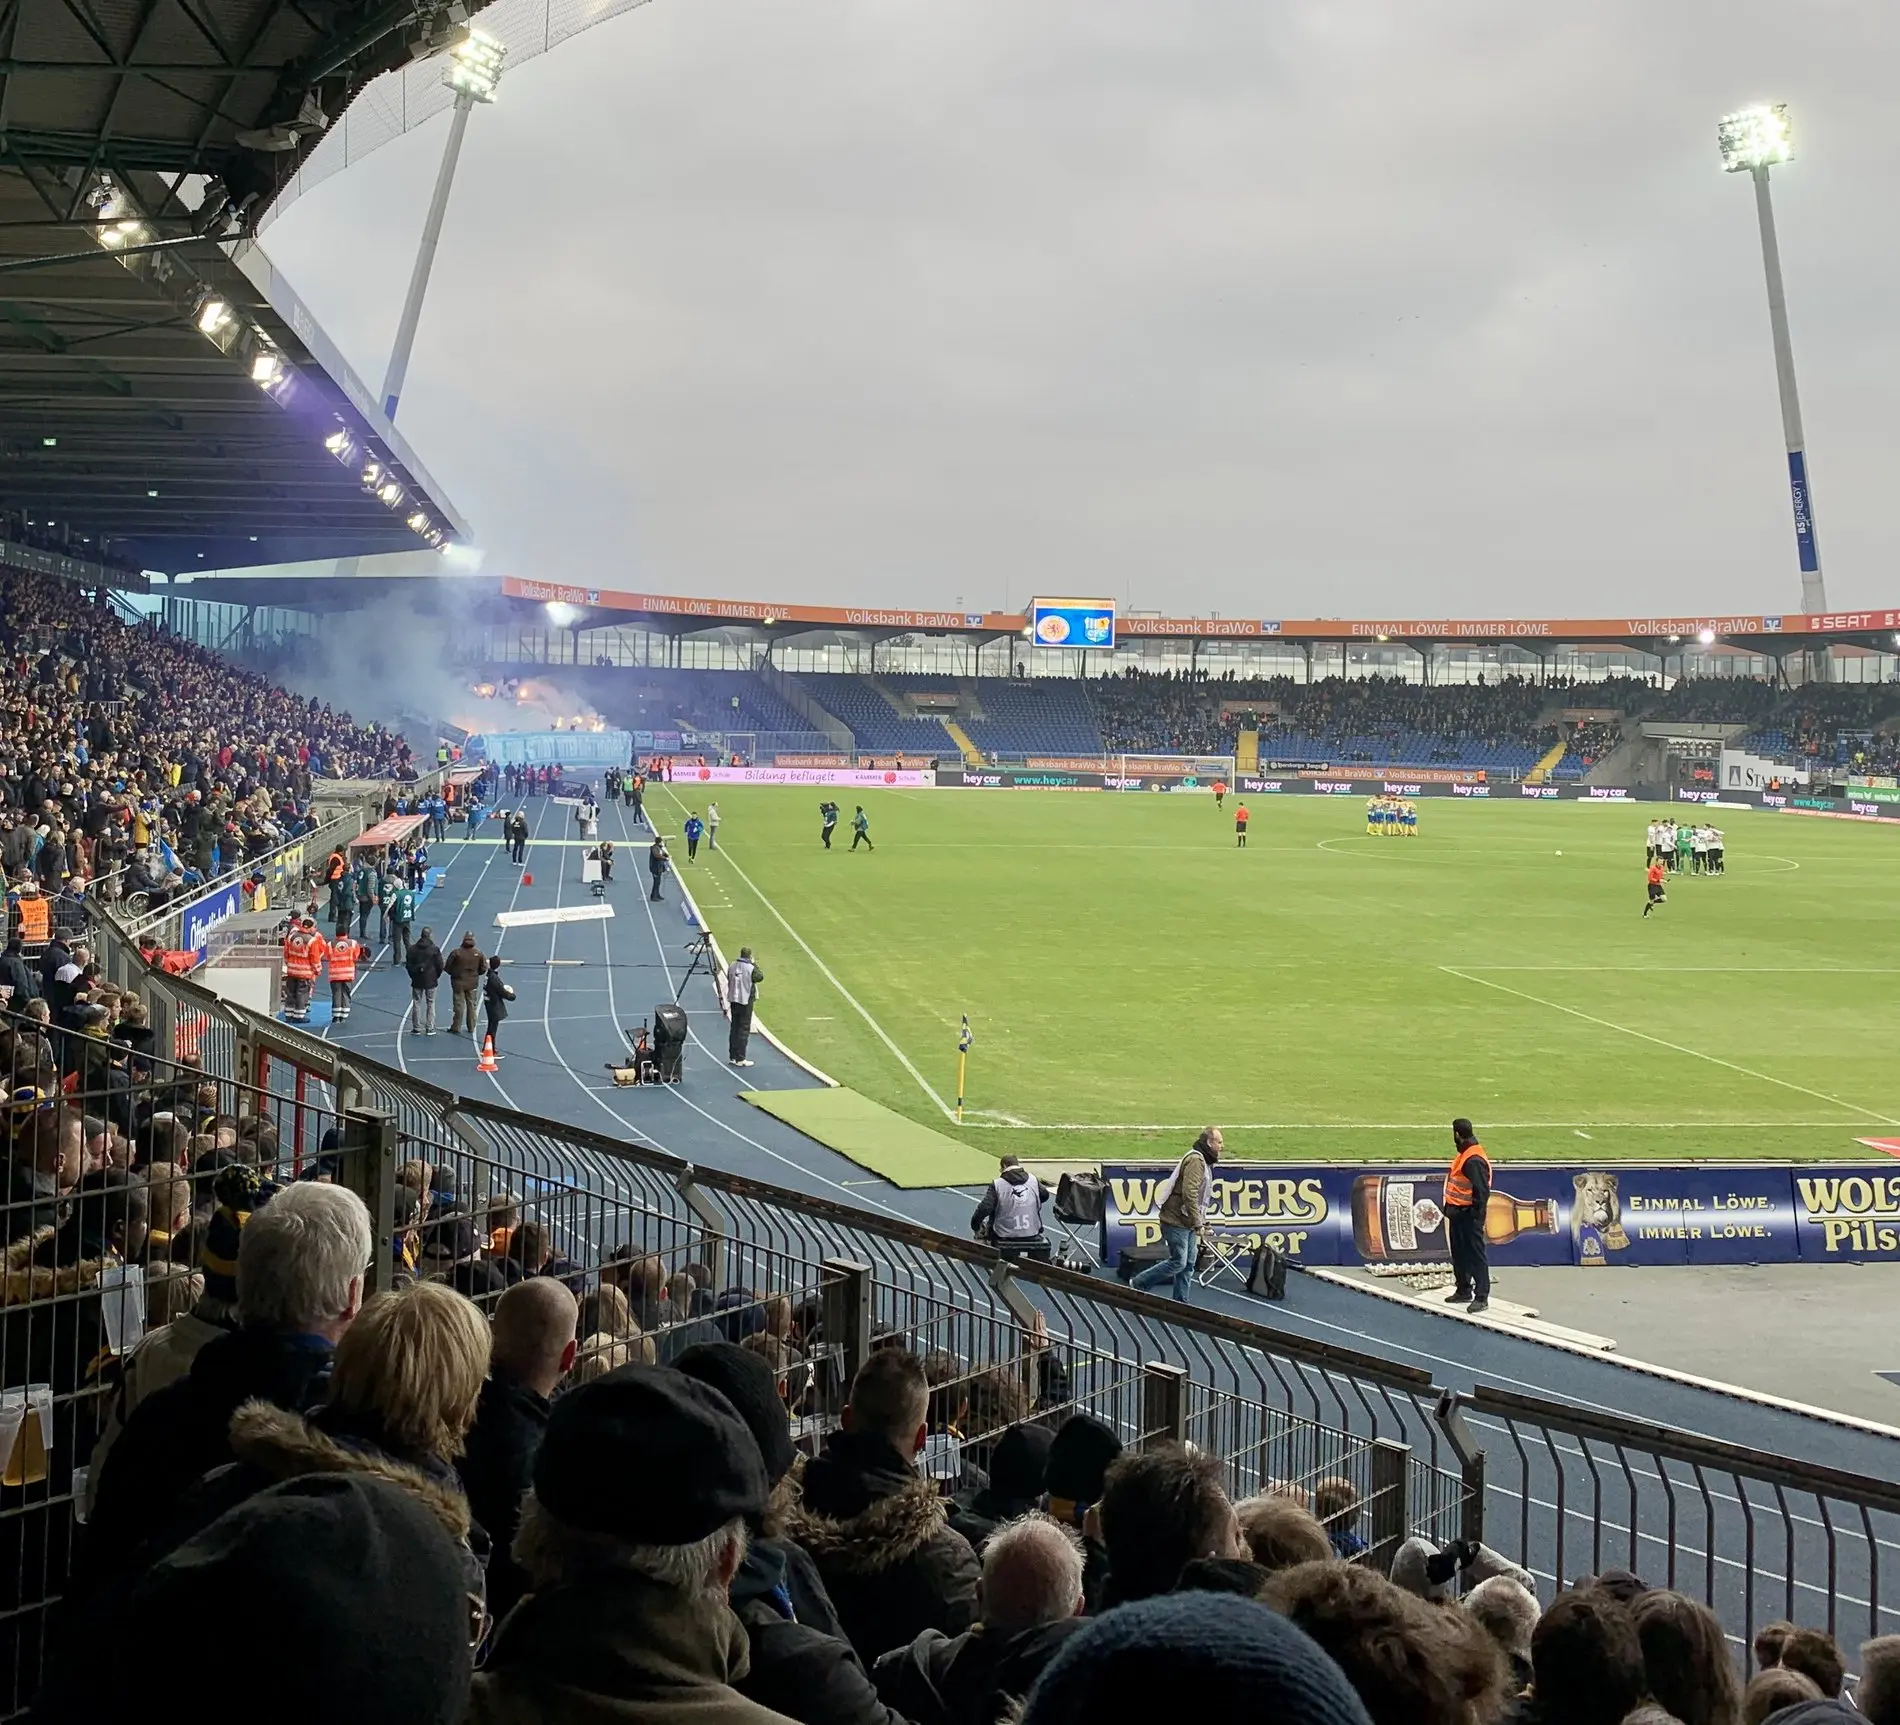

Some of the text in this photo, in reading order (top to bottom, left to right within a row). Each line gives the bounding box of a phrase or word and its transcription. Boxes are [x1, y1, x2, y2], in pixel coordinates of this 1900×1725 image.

[557, 585, 584, 604] BraWo
[643, 598, 791, 619] EINMAL LÖWE. IMMER LÖWE.
[845, 610, 959, 627] Volksbank BraWo
[1823, 614, 1872, 629] SEAT
[1128, 620, 1255, 634] Volksbank BraWo
[1352, 621, 1552, 635] EINMAL LÖWE. IMMER LÖWE.
[1628, 619, 1757, 633] Volksbank BraWo
[777, 756, 836, 766] Volksbank BraWo
[1028, 759, 1095, 769] Volksbank BraWo
[1154, 763, 1180, 771] BraWo
[745, 770, 786, 784] Bildung
[1344, 767, 1372, 778] BraWo
[1389, 768, 1461, 781] Volksbank BraWo
[1109, 1177, 1328, 1225] WTERS
[1013, 1214, 1030, 1230] 15
[1823, 1219, 1900, 1252] Pils
